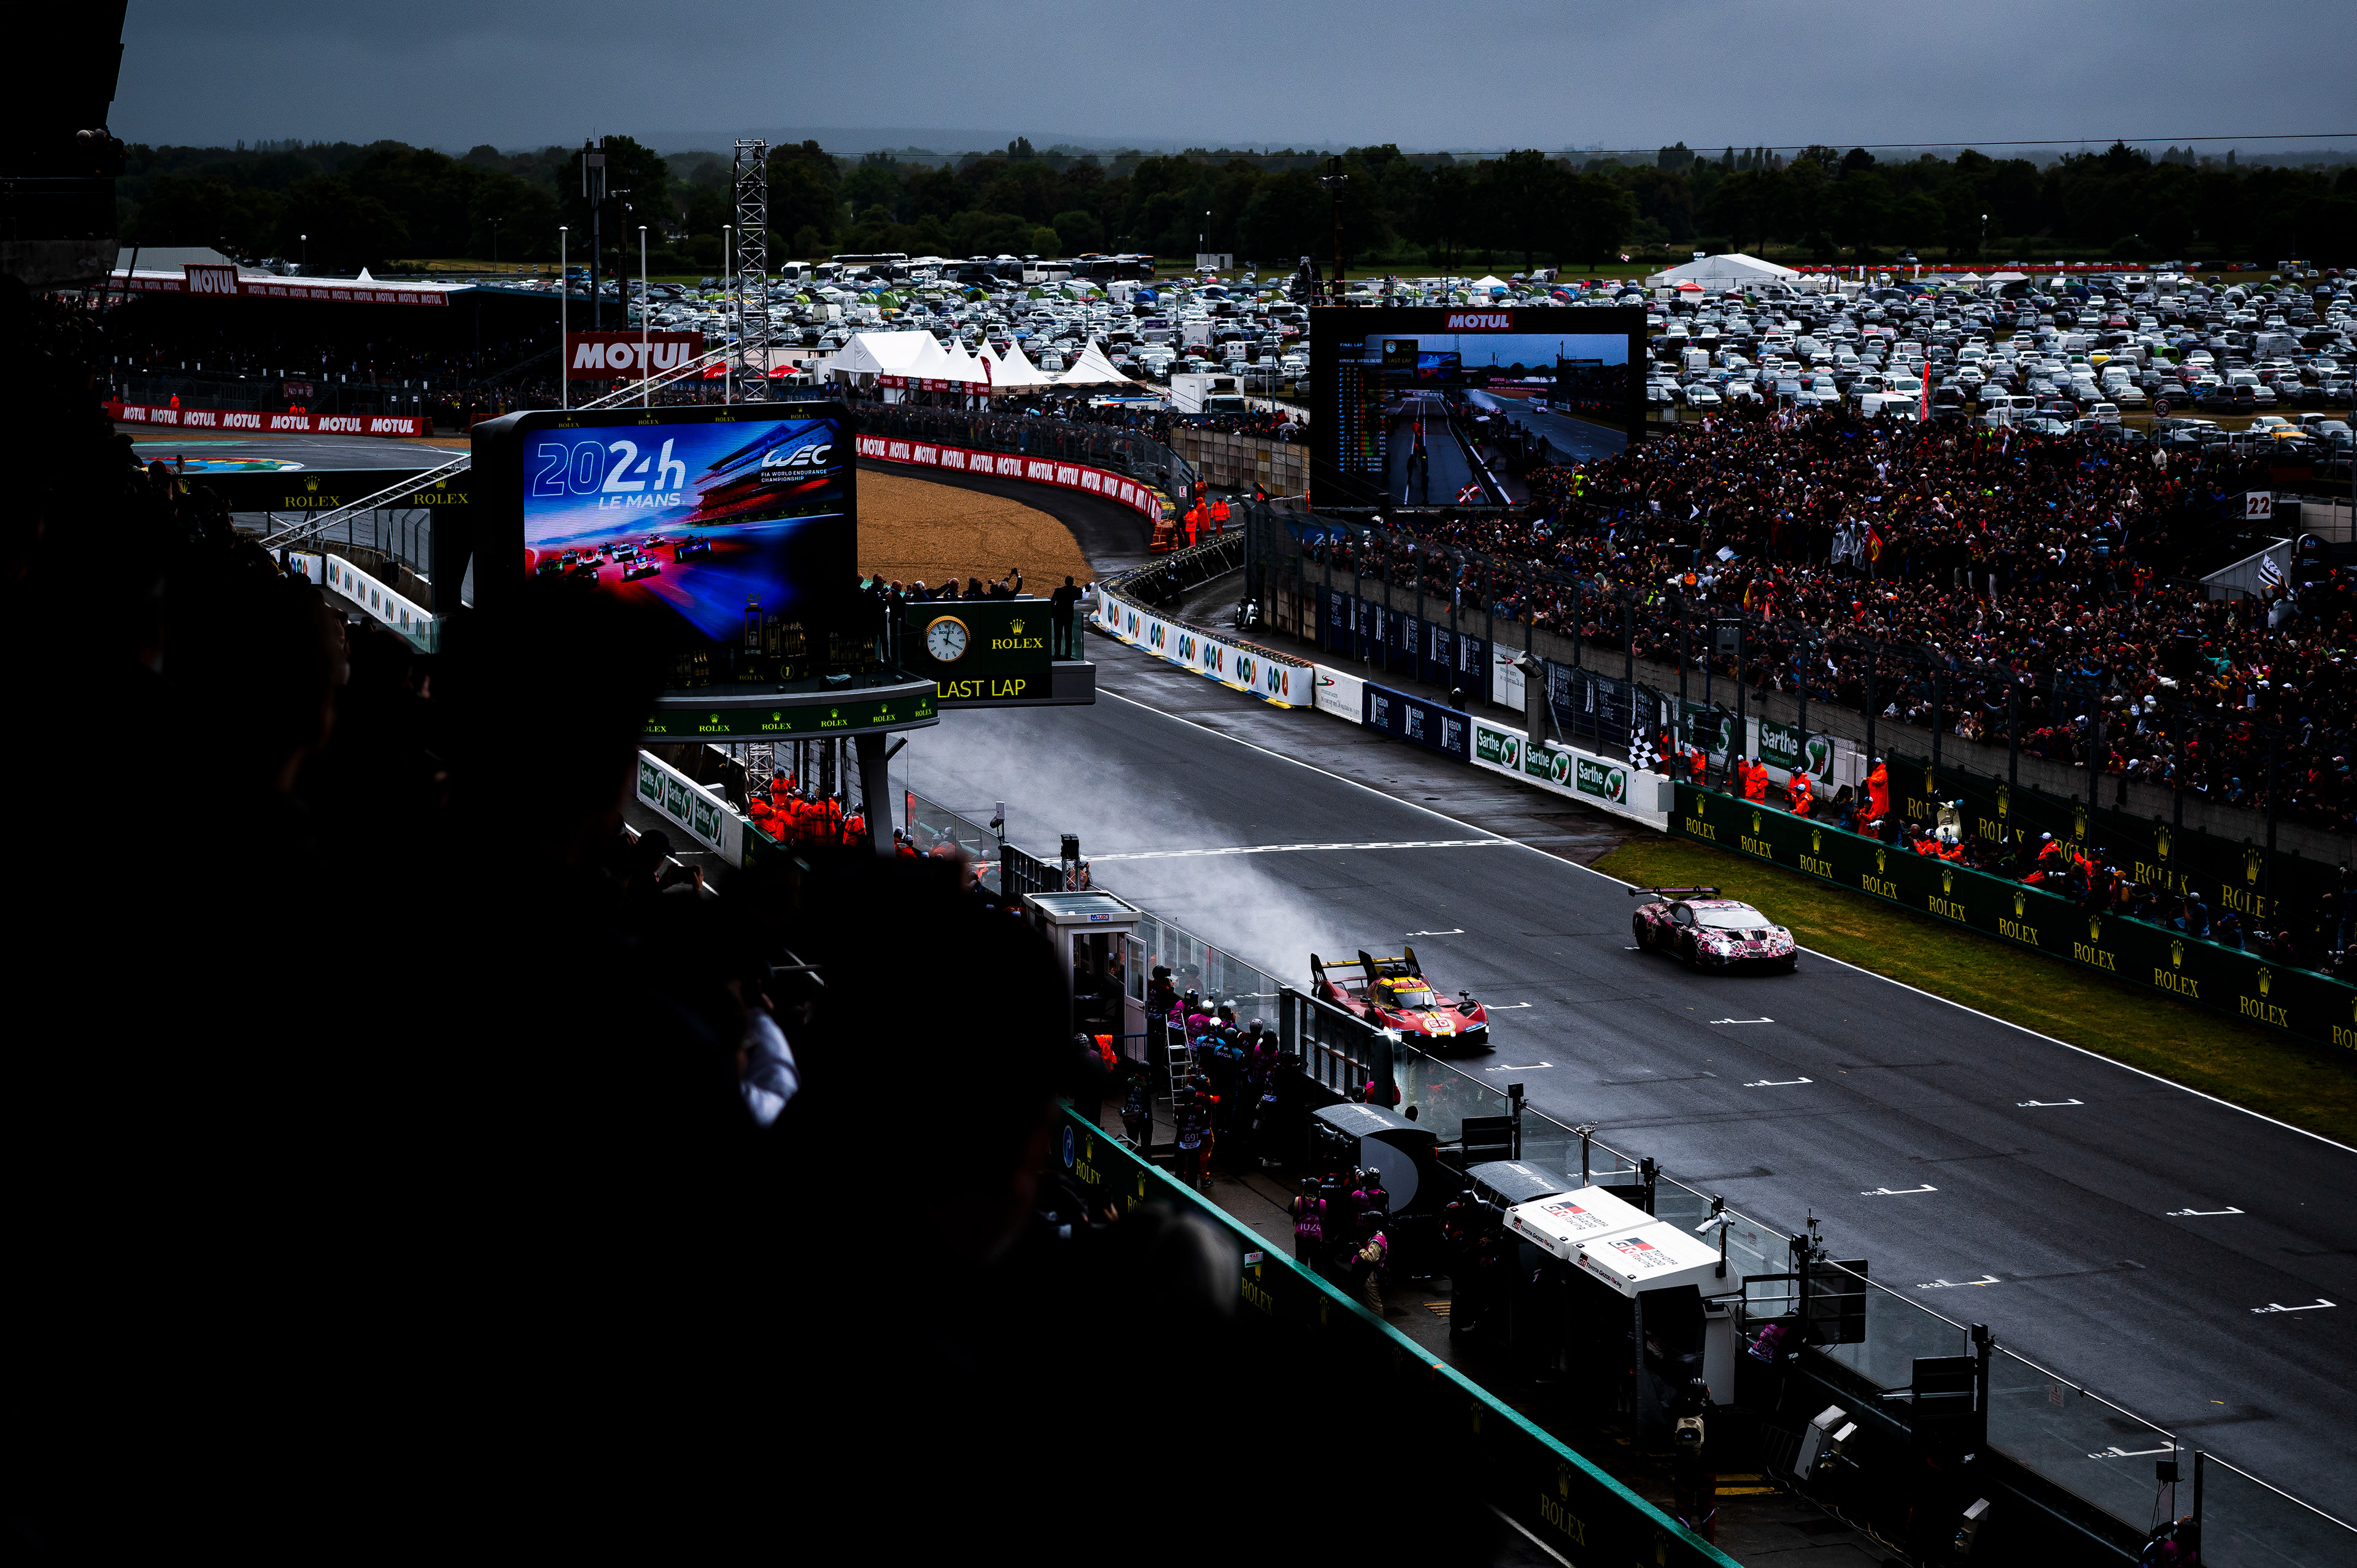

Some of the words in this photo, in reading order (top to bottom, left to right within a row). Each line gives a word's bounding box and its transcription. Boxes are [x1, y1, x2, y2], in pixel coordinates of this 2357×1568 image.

[145, 280, 161, 290] MOTUL
[163, 281, 180, 291] MOTUL
[190, 269, 237, 294] MOTUL
[248, 285, 266, 295] MOTUL
[269, 286, 287, 296] MOTUL
[290, 287, 308, 298] MOTUL
[311, 288, 329, 299] MOTUL
[332, 290, 351, 300] MOTUL
[354, 291, 373, 301] MOTUL
[376, 292, 395, 303] MOTUL
[398, 293, 418, 303] MOTUL
[421, 294, 442, 304] MOTUL
[1448, 314, 1509, 328] MOTUL
[573, 342, 697, 369] MOTUL
[123, 406, 145, 420] MOTUL
[151, 409, 177, 424] MOTUL
[184, 411, 216, 427] MOTUL
[223, 413, 261, 428] MOTUL
[271, 415, 310, 430] MOTUL
[319, 417, 362, 432] MOTUL
[370, 418, 414, 433] MOTUL
[761, 445, 832, 467] WEC
[862, 438, 885, 457] MOTUL
[889, 441, 910, 460] MOTUL
[913, 445, 937, 465] MOTUL
[941, 449, 964, 469] MOTUL
[970, 454, 993, 473] MOTUL
[996, 457, 1022, 476] MOTUL
[1028, 461, 1053, 481] MOTUL
[1082, 470, 1101, 492] MOTUL
[284, 496, 341, 508] ROLEX
[413, 493, 468, 504] ROLEX
[598, 496, 624, 509] LE
[2248, 496, 2269, 514] 22
[992, 638, 1043, 649] ROLEX
[785, 666, 789, 676] 1
[937, 680, 985, 698] LAST
[991, 679, 1026, 697] LAP
[1556, 679, 1568, 693] PAYS
[1377, 696, 1388, 708] RÉGION
[821, 719, 848, 727] ROLEX
[873, 714, 896, 723] ROLEX
[915, 708, 932, 717] ROLEX
[1412, 708, 1424, 720] RÉGION
[1415, 730, 1423, 740] LOIRE
[1449, 719, 1461, 732] RÉGION
[1449, 730, 1457, 741] PAYS
[1478, 730, 1500, 752] Sarthe
[1762, 724, 1798, 755] Sarthe
[1452, 742, 1461, 752] LOIRE
[1527, 746, 1549, 767] Sarthe
[1766, 749, 1790, 765] Département
[641, 764, 654, 787] Sarthe
[1579, 762, 1603, 784] Sarthe
[668, 781, 681, 805] Sarthe
[696, 800, 710, 824] Sarthe
[1686, 817, 1716, 840] ROLEX
[1741, 835, 1772, 859] ROLEX
[1800, 854, 1832, 879] ROLEX
[1862, 875, 1897, 900] ROLEX
[1929, 895, 1966, 922] ROLEX
[1999, 917, 2038, 946] ROLEX
[2073, 941, 2116, 971] ROLEX
[2154, 968, 2199, 999] ROLEX
[2240, 995, 2288, 1028] ROLEX
[1185, 1134, 1199, 1142] 691
[1542, 1204, 1574, 1217] GR
[1583, 1213, 1609, 1227] TOYOTA
[1563, 1216, 1586, 1230] Racing
[1573, 1215, 1596, 1228] GAZOO
[1512, 1221, 1520, 1230] GR
[1520, 1226, 1533, 1237] TOYOTA
[1533, 1233, 1544, 1243] GAZOO
[1544, 1239, 1555, 1250] Racing
[1609, 1240, 1643, 1254] GR
[1651, 1249, 1678, 1265] TOYOTA
[1630, 1254, 1654, 1268] Racing
[1640, 1252, 1665, 1265] GAZOO
[1578, 1257, 1586, 1267] GR
[1586, 1262, 1599, 1273] TOYOTA
[1599, 1270, 1611, 1281] GAZOO
[1611, 1277, 1622, 1289] Racing
[1242, 1276, 1273, 1316] ROLEX
[1541, 1493, 1586, 1547] ROLEX
